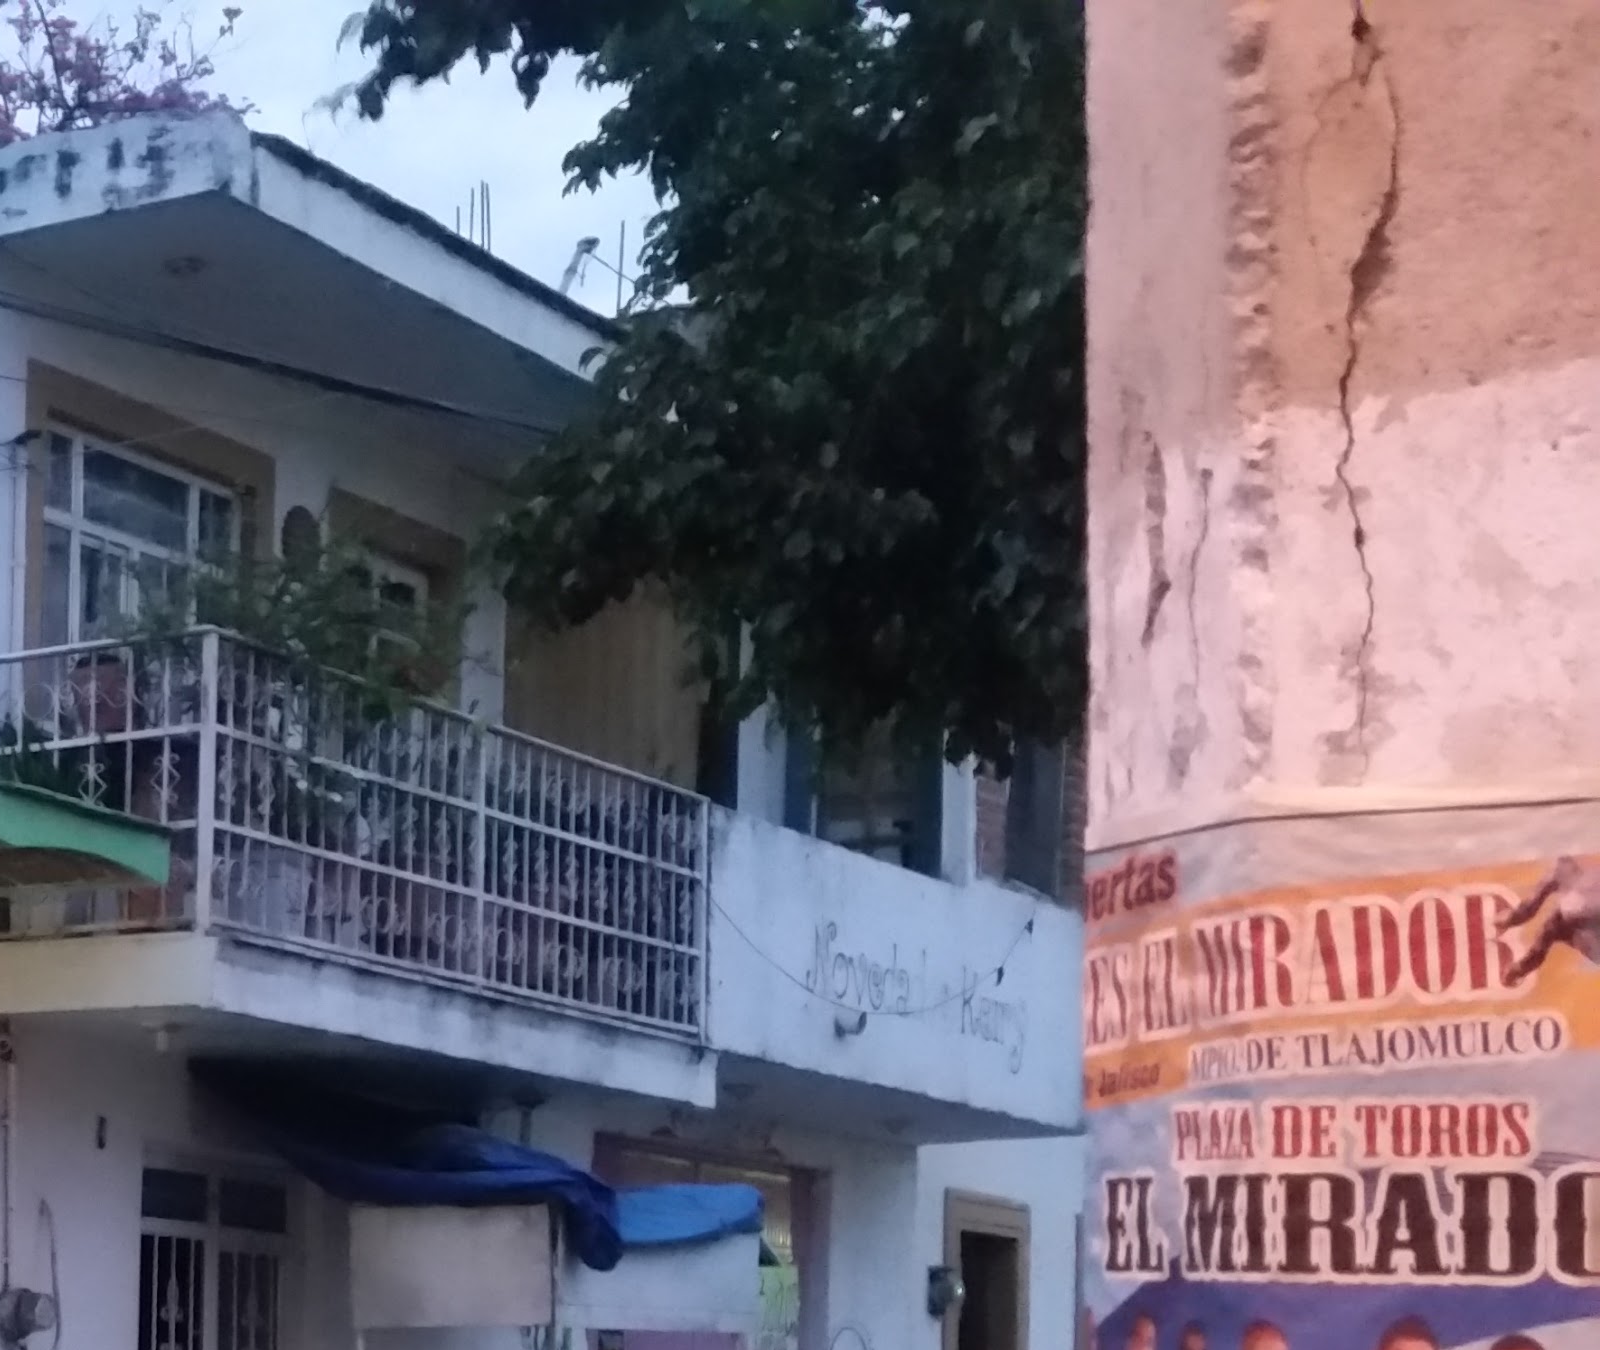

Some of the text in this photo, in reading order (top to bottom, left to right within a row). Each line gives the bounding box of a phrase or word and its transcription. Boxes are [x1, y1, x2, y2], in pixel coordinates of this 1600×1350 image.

[1197, 893, 1516, 1017] MIRADOR
[1247, 1036, 1286, 1072] DE
[1296, 1016, 1562, 1067] TLAJOMULCO
[1176, 1102, 1531, 1160] PLAZA DE TOROS
[1105, 1177, 1164, 1272] EL
